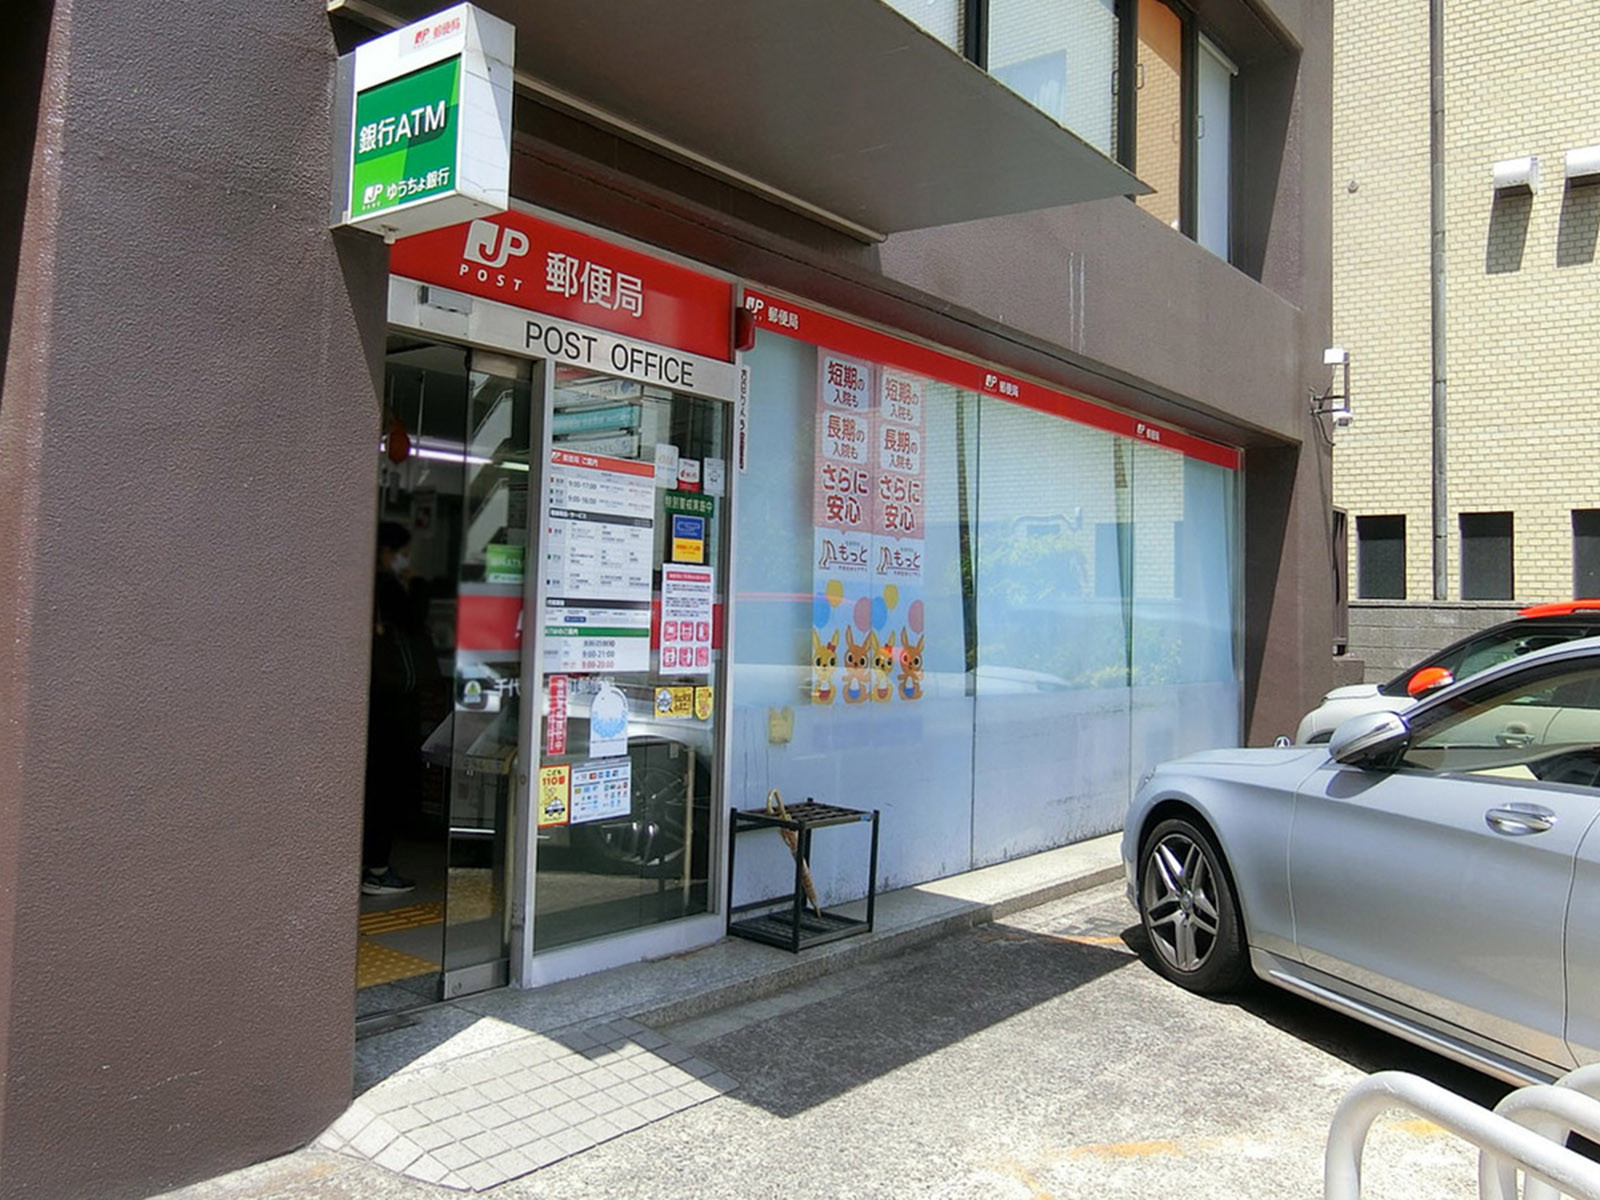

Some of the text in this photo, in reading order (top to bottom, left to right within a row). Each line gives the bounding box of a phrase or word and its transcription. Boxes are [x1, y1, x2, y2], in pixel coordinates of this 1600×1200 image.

[359, 100, 446, 153] 銀行ATM
[386, 167, 450, 201] ゆうちょ銀行
[459, 264, 522, 291] POST
[545, 251, 644, 318] 郵便局
[768, 306, 798, 330] 郵便局
[526, 321, 694, 387] POST OFFICE
[828, 361, 865, 392] 短期の
[834, 389, 859, 408] 入院も
[885, 377, 919, 405] 短期の
[828, 415, 865, 443] 長期の
[884, 429, 917, 454] 長期の
[822, 464, 868, 494] さらに
[880, 475, 920, 503] さらに
[827, 495, 861, 524] 安心
[885, 504, 915, 531] 安心
[838, 544, 868, 563] もっと
[894, 550, 920, 567] もっと
